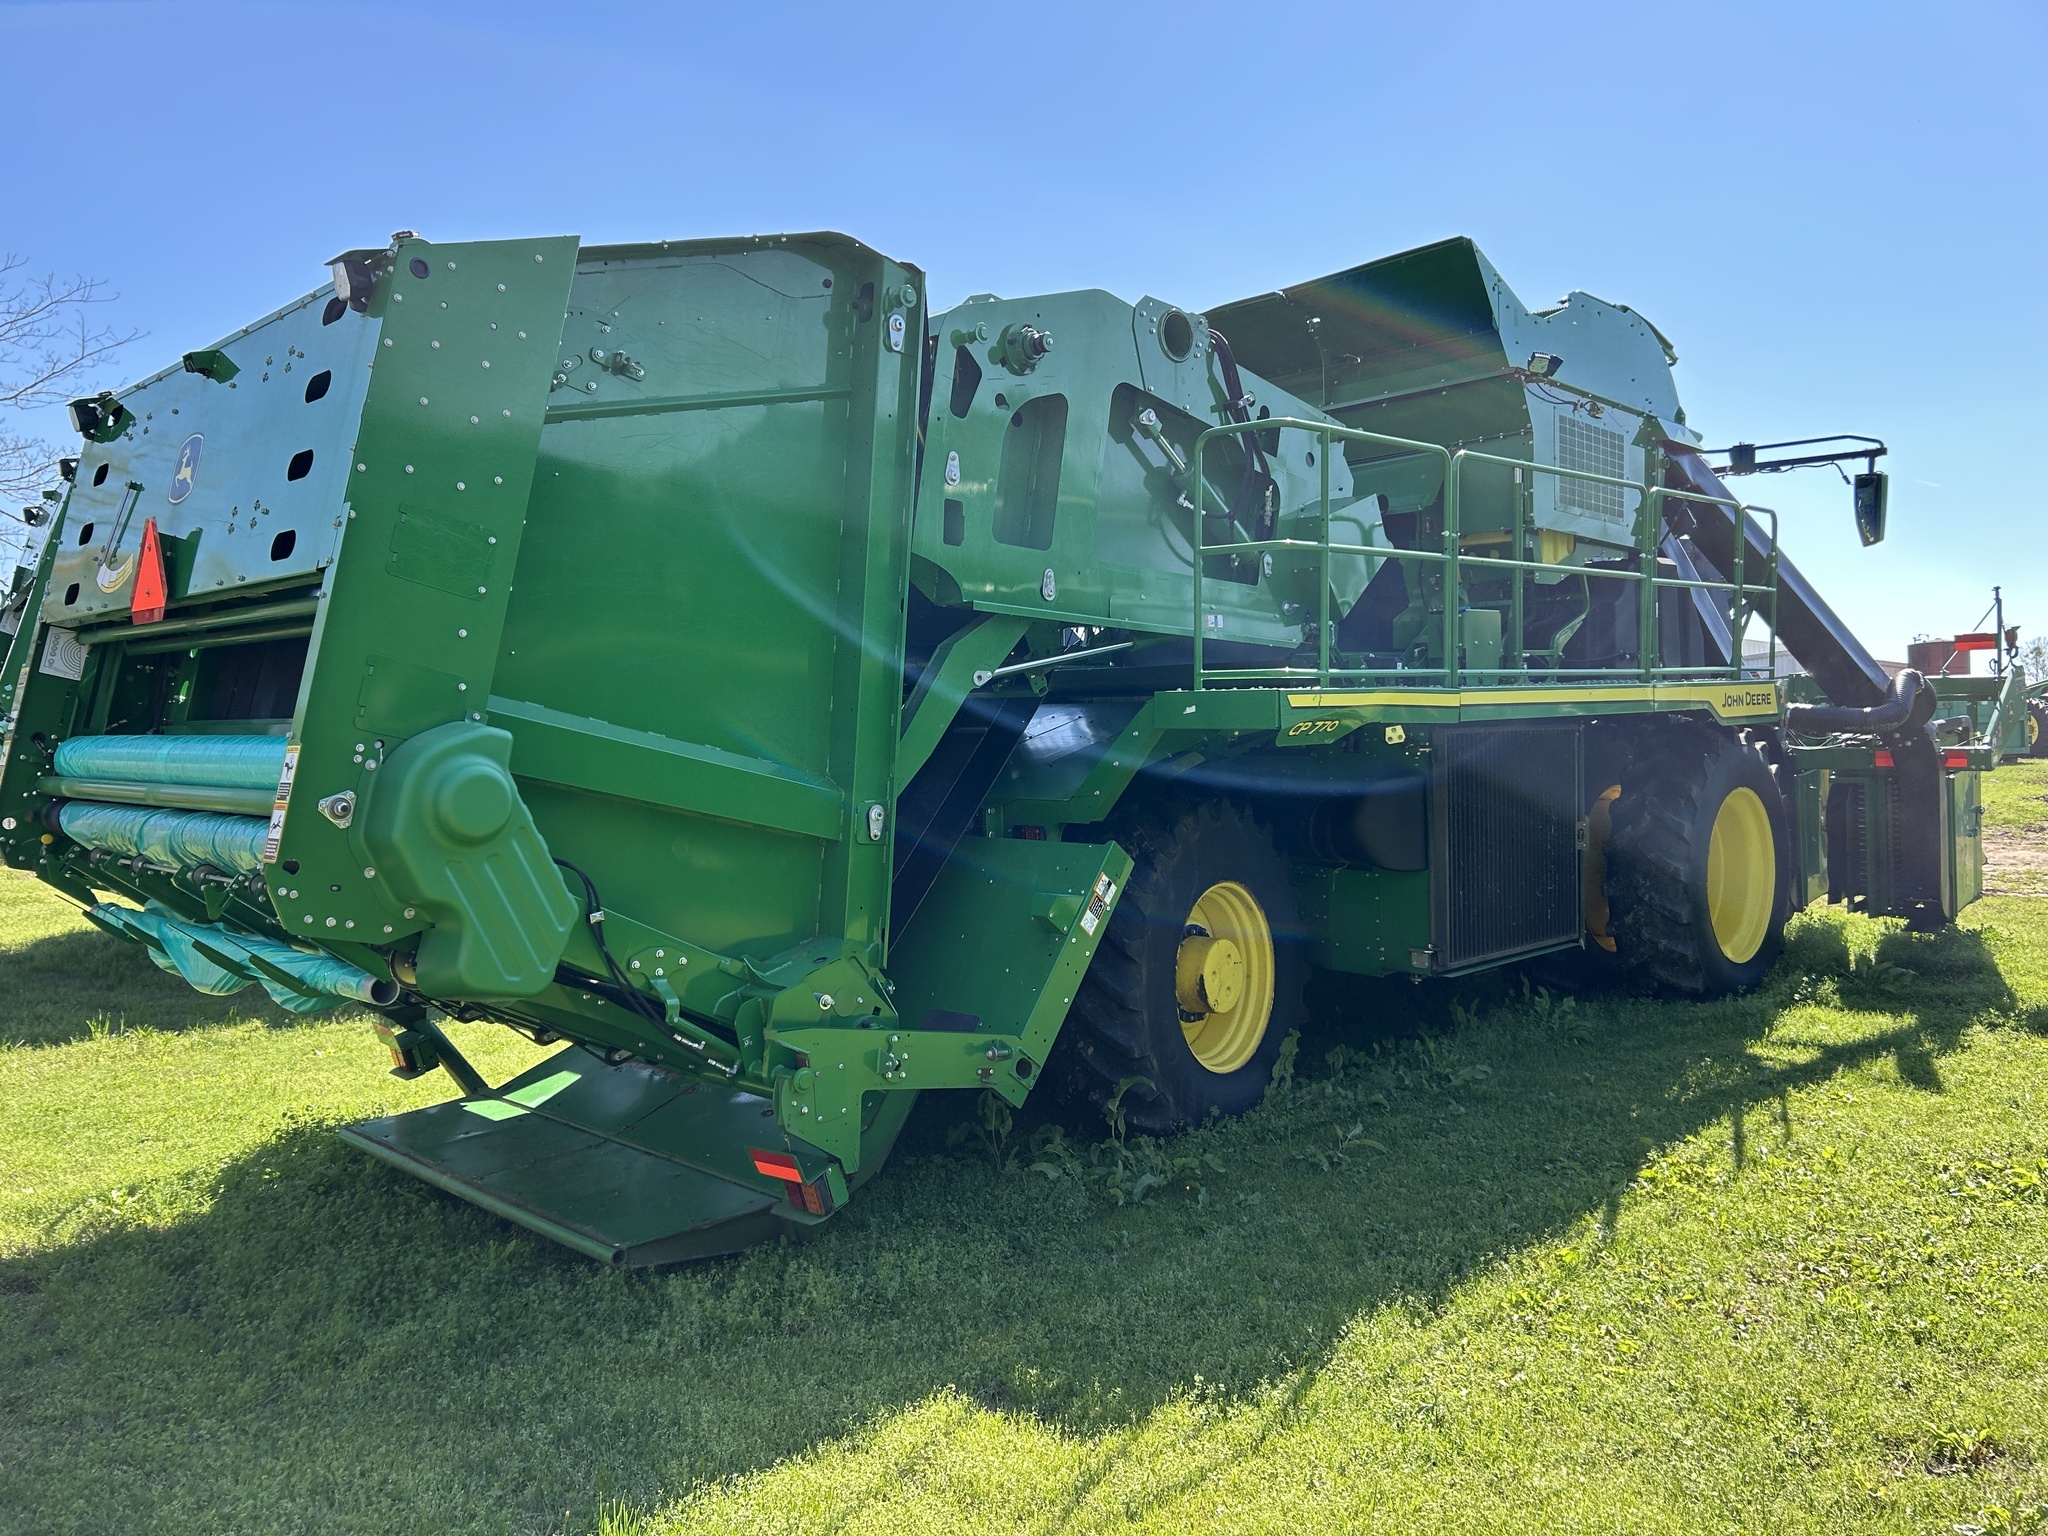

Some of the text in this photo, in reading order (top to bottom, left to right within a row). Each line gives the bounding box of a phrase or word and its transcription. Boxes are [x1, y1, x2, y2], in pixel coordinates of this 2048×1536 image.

[1722, 691, 1772, 708] JOHN DEERE
[1288, 720, 1340, 736] CP 770
